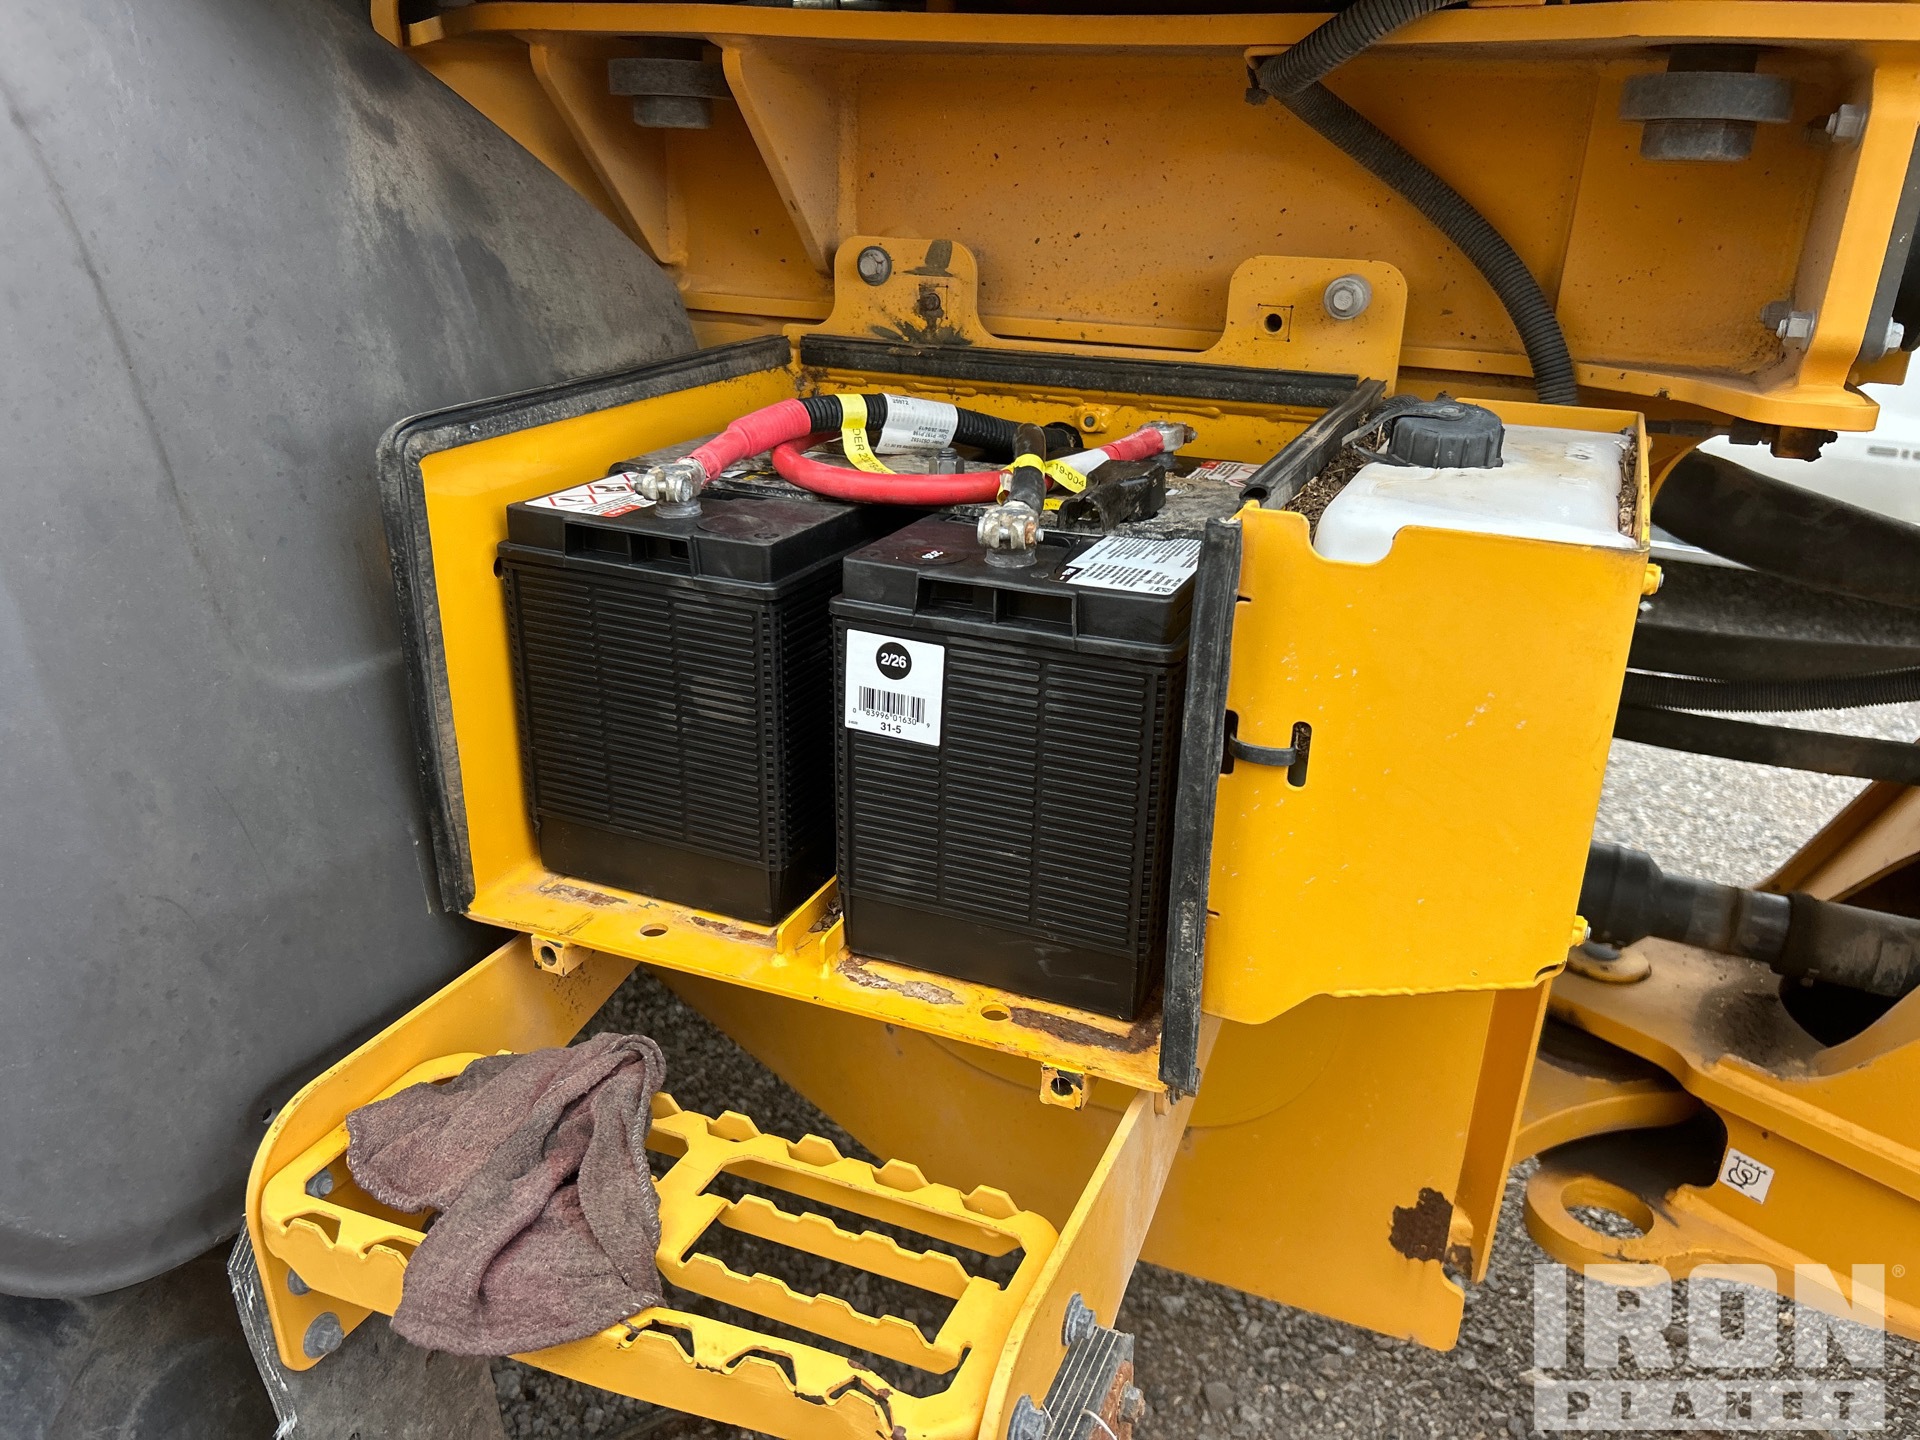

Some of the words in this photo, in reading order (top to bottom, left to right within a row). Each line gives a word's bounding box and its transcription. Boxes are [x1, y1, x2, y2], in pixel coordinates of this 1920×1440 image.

[880, 652, 907, 669] 2/26
[865, 707, 890, 720] 83996
[892, 714, 917, 726] 01630
[880, 721, 902, 735] 31-5
